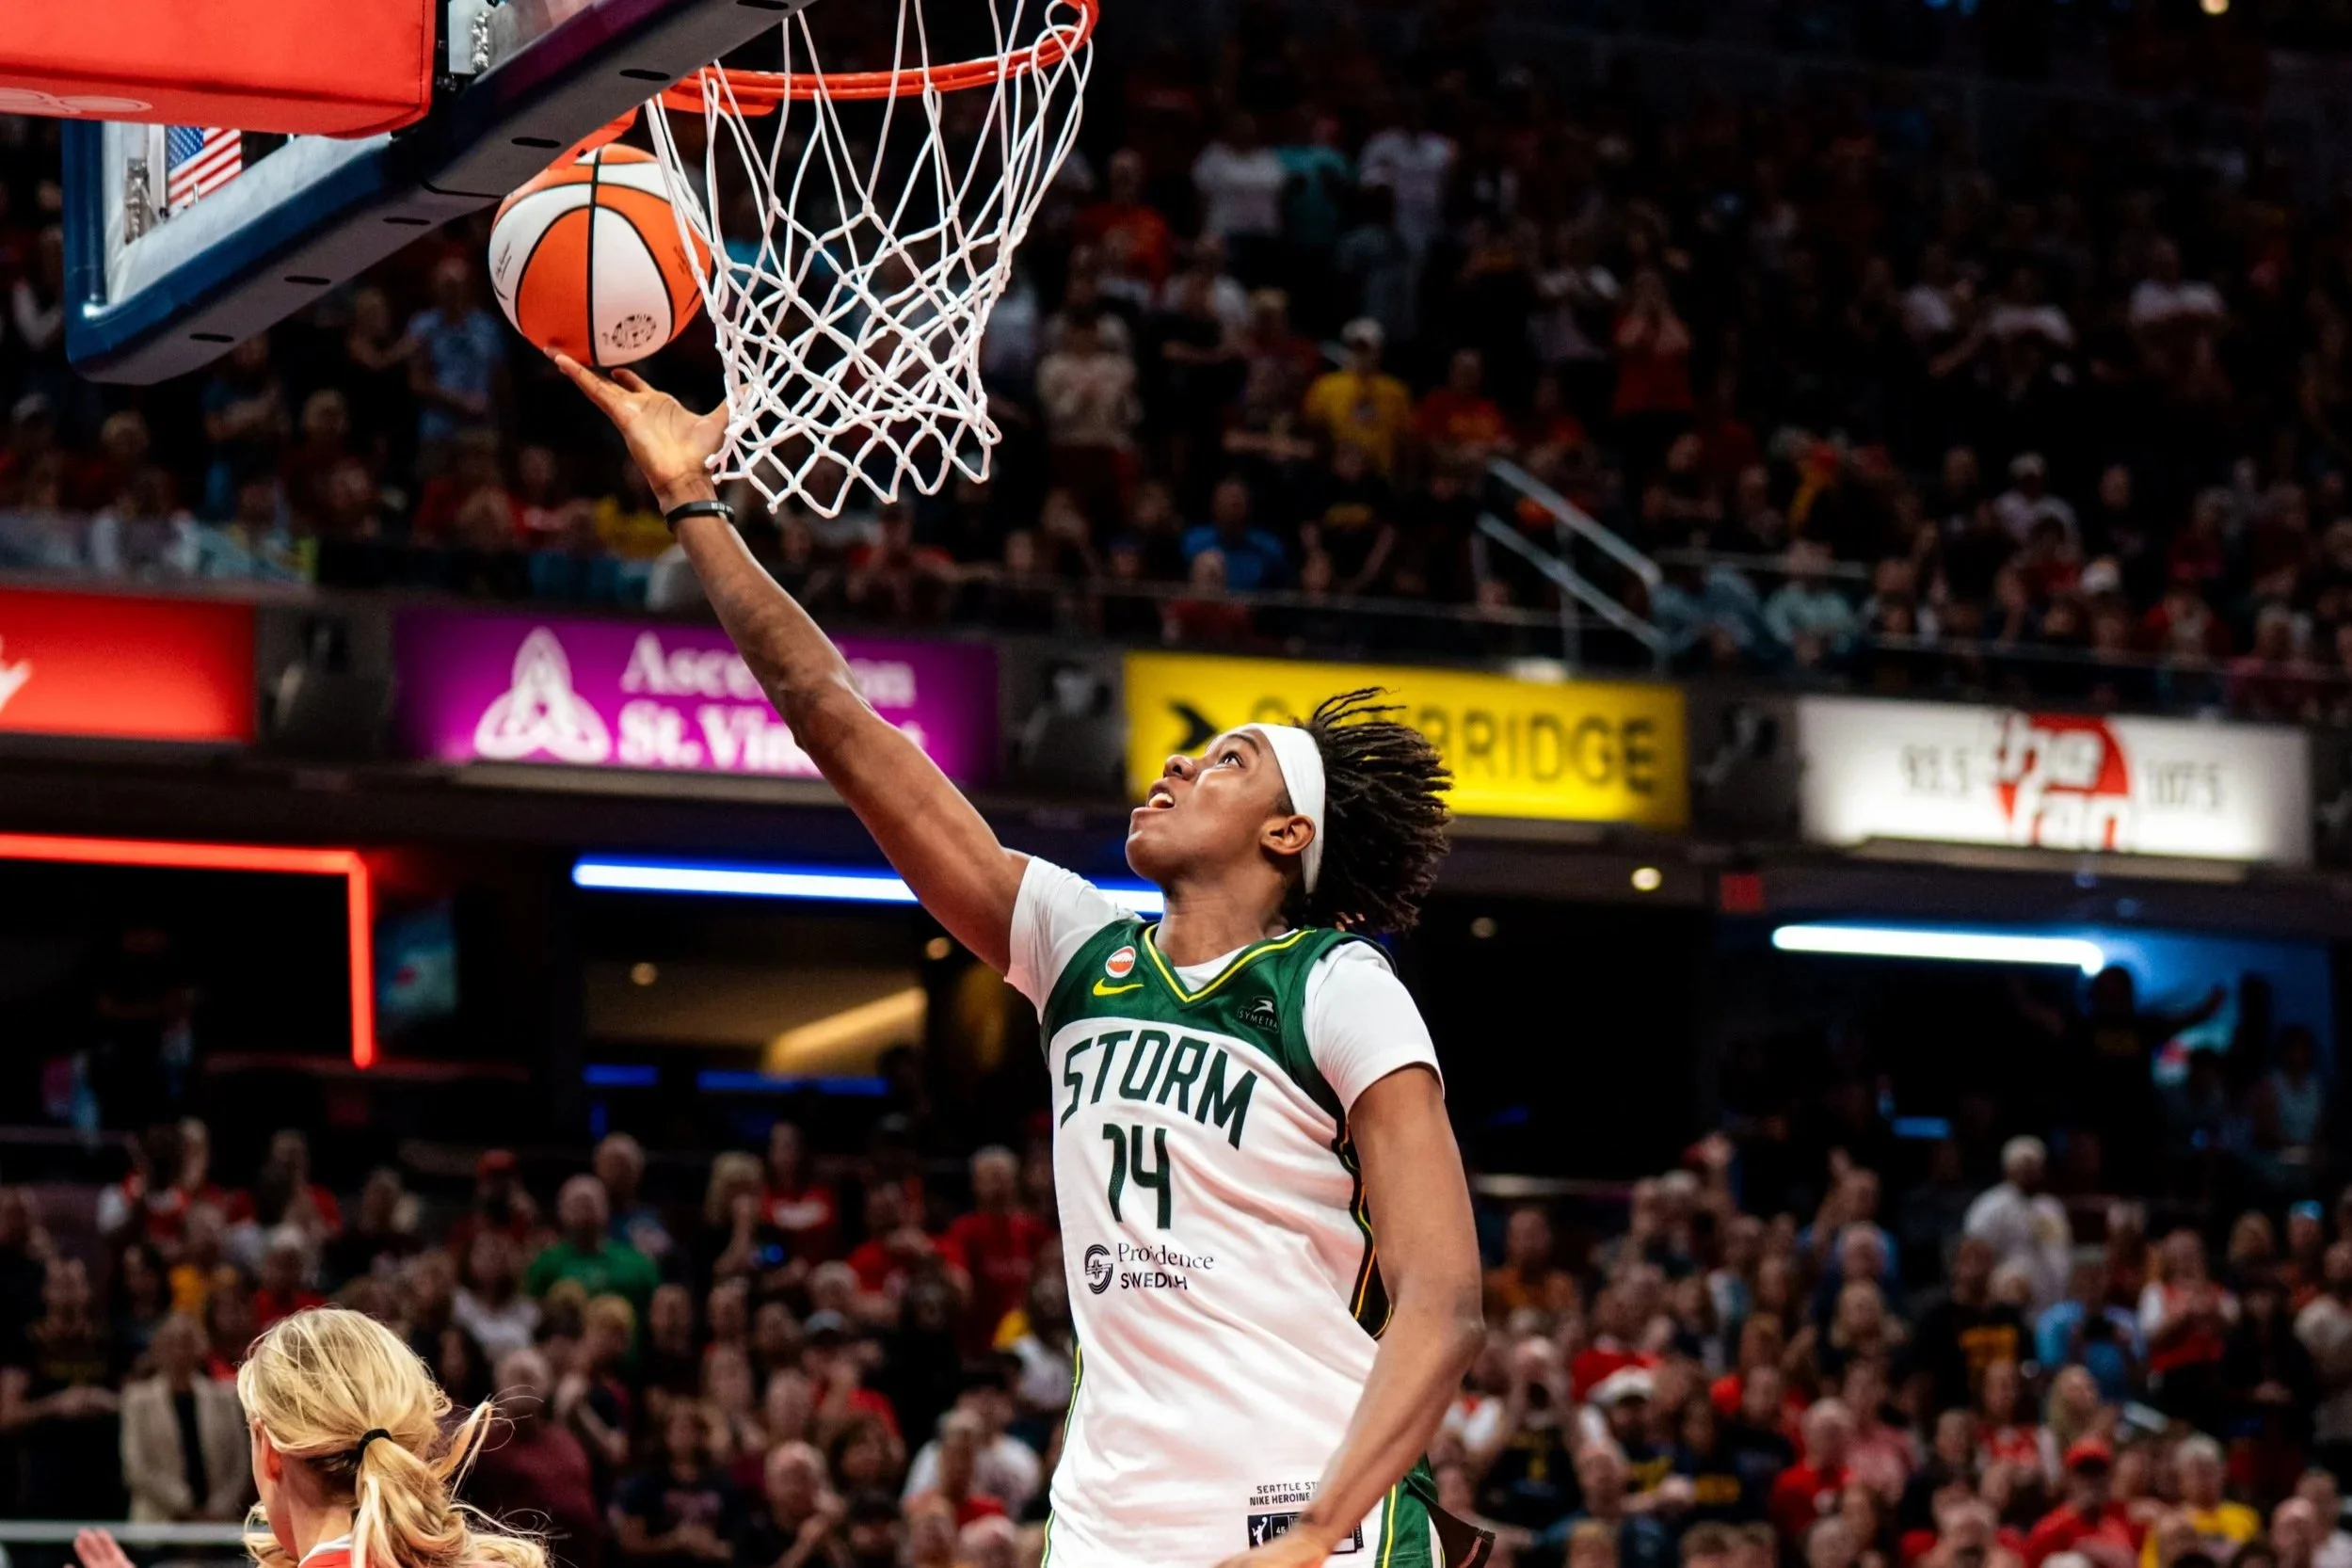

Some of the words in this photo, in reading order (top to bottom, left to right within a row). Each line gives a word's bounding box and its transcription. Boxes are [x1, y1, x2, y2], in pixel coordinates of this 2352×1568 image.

[1060, 1030, 1258, 1150] STORM
[1102, 1123, 1172, 1229] 14
[1249, 1495, 1270, 1506] NIKE
[1272, 1492, 1311, 1504] HEROINE
[1256, 1482, 1302, 1495] SEATTLE
